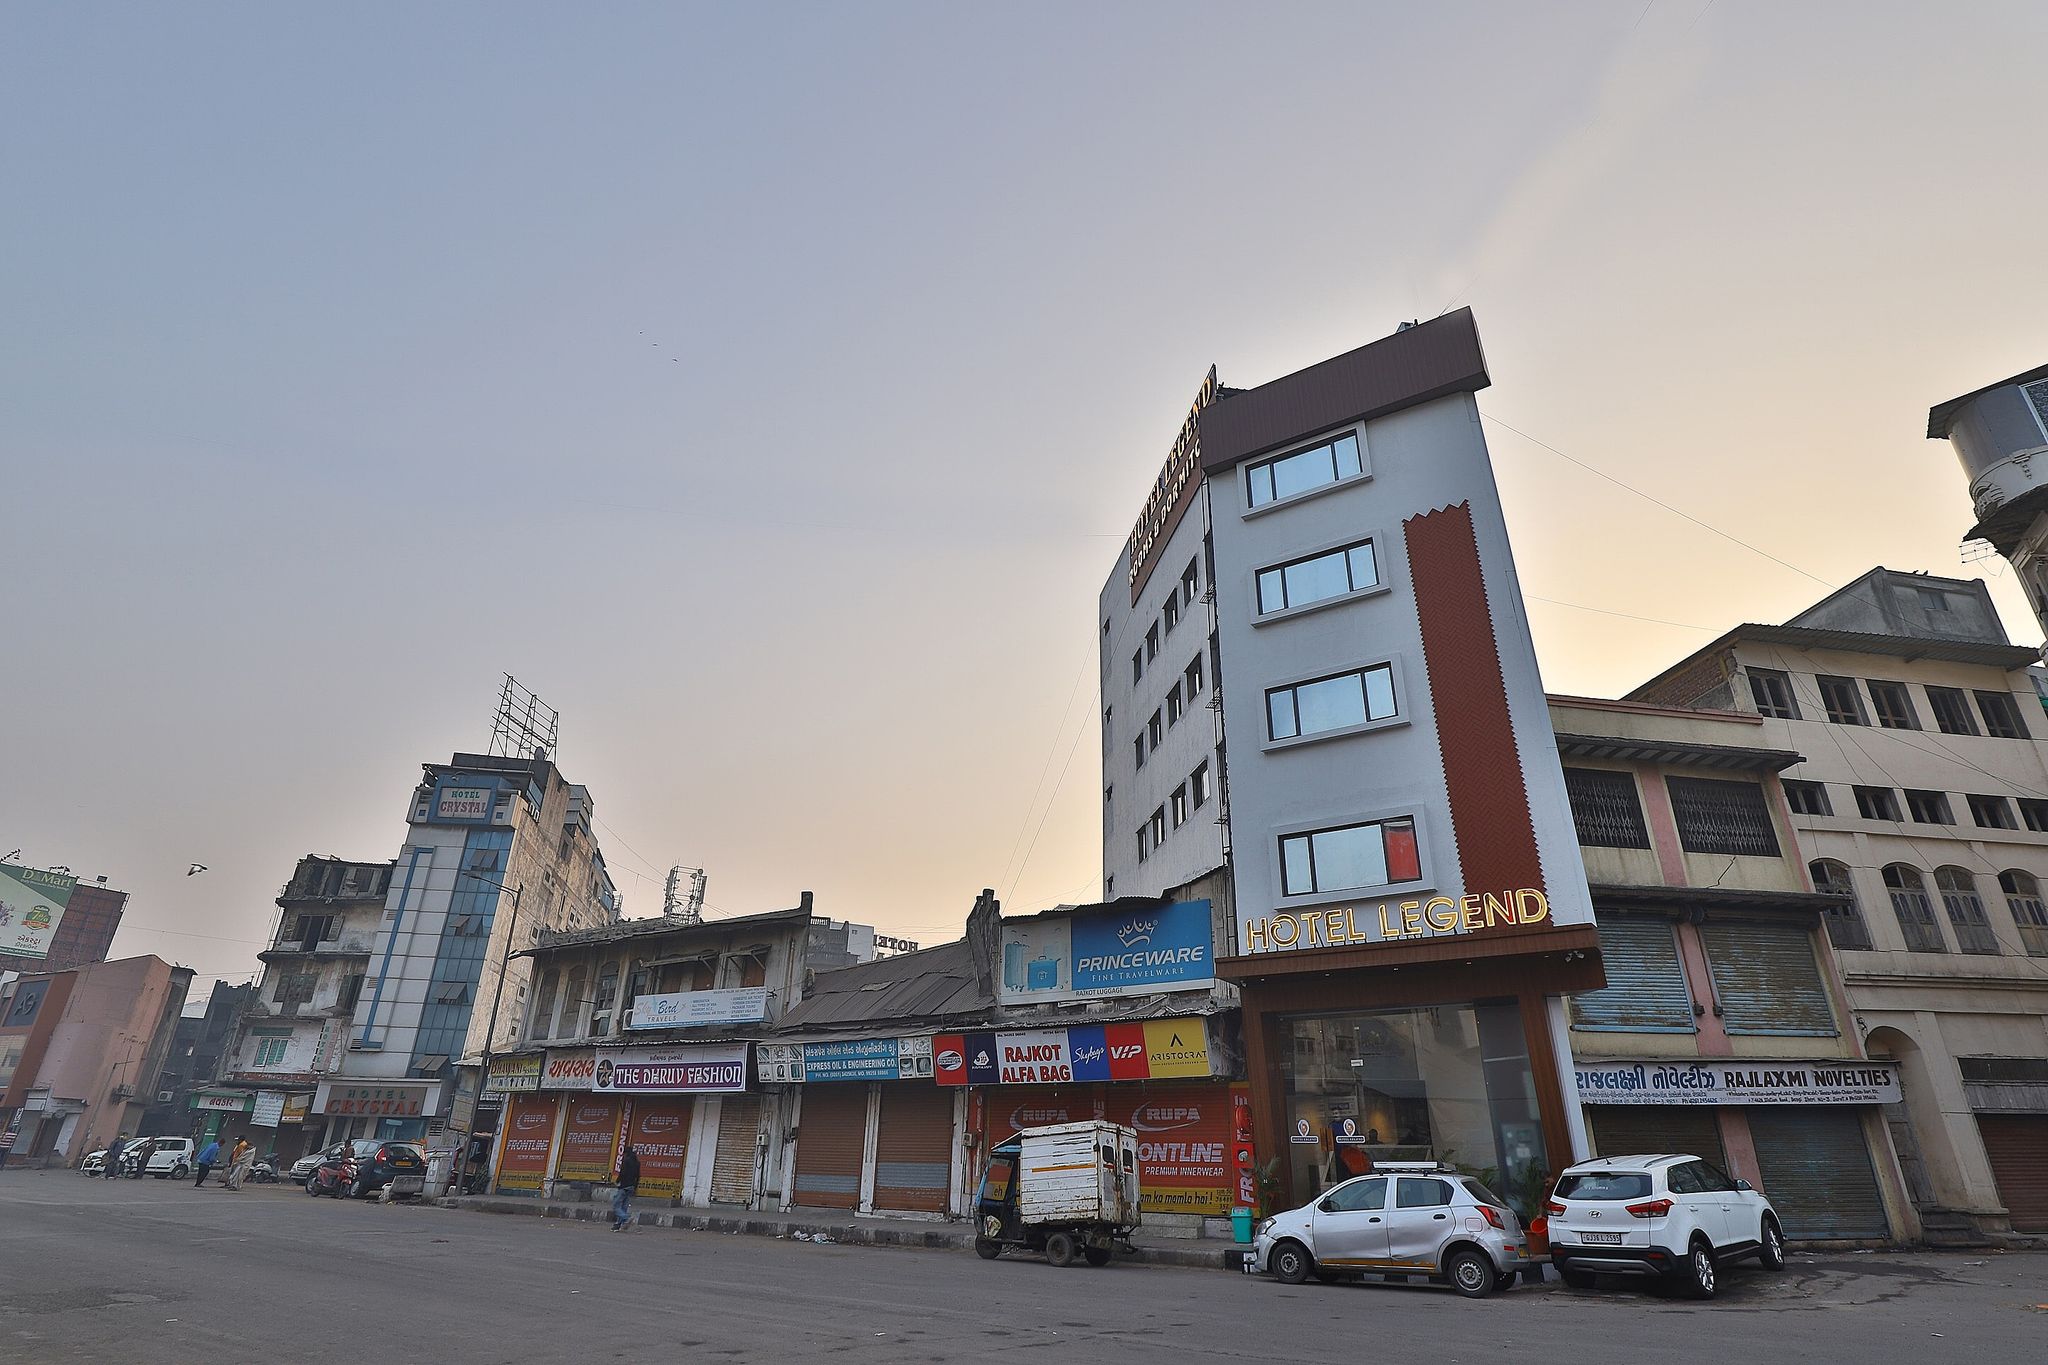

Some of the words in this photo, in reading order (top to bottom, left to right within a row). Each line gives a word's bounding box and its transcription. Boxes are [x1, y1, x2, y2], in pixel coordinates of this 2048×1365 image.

[1130, 479, 1163, 555] HOTEL
[1164, 378, 1212, 483] LEGEND
[1129, 530, 1154, 587] ROOMS
[1154, 520, 1161, 537] &
[441, 801, 487, 813] CRYSTAL
[23, 870, 34, 879] D
[42, 873, 72, 887] Mart
[1245, 908, 1366, 950] HOTEL
[1379, 888, 1548, 938] LEGEND
[1078, 946, 1204, 972] PRINCEWARE
[1092, 974, 1114, 982] FINE
[1120, 968, 1184, 980] TRAVELWARE
[1097, 987, 1123, 995] LUGGAGE
[658, 1000, 680, 1014] Bird
[1005, 1045, 1061, 1062] RAJKOT
[1073, 1046, 1105, 1064] Skybags
[1110, 1045, 1142, 1059] VIP
[1150, 1050, 1207, 1061] ARISTOCRAT
[807, 1062, 831, 1070] EXPRESS
[832, 1061, 841, 1069] OIL
[848, 1059, 885, 1069] ENGINEERING
[887, 1058, 897, 1067] CO.
[616, 1069, 639, 1084] THE
[643, 1067, 684, 1085] DHRUV
[1002, 1066, 1037, 1082] ALFA
[1040, 1065, 1071, 1081] BAG
[1575, 1063, 1647, 1091] રાજલક્ષ્મી
[1724, 1071, 1808, 1088] RAJLAXMI
[1813, 1070, 1891, 1087] NOVELTIES
[348, 1089, 406, 1099] HOTEL
[326, 1100, 418, 1115] CRYSTAL
[1147, 1108, 1201, 1121] RUPA
[651, 1116, 679, 1125] RUPA
[1023, 1109, 1069, 1121] RUPA
[615, 1100, 632, 1172] FRONTLINE
[507, 1139, 549, 1151] FRONTLINE
[632, 1143, 684, 1157] FRONTLINE
[1137, 1143, 1224, 1162] ONTLINE
[1145, 1166, 1176, 1176] PREMIUM
[1180, 1167, 1224, 1177] INNERWEAR
